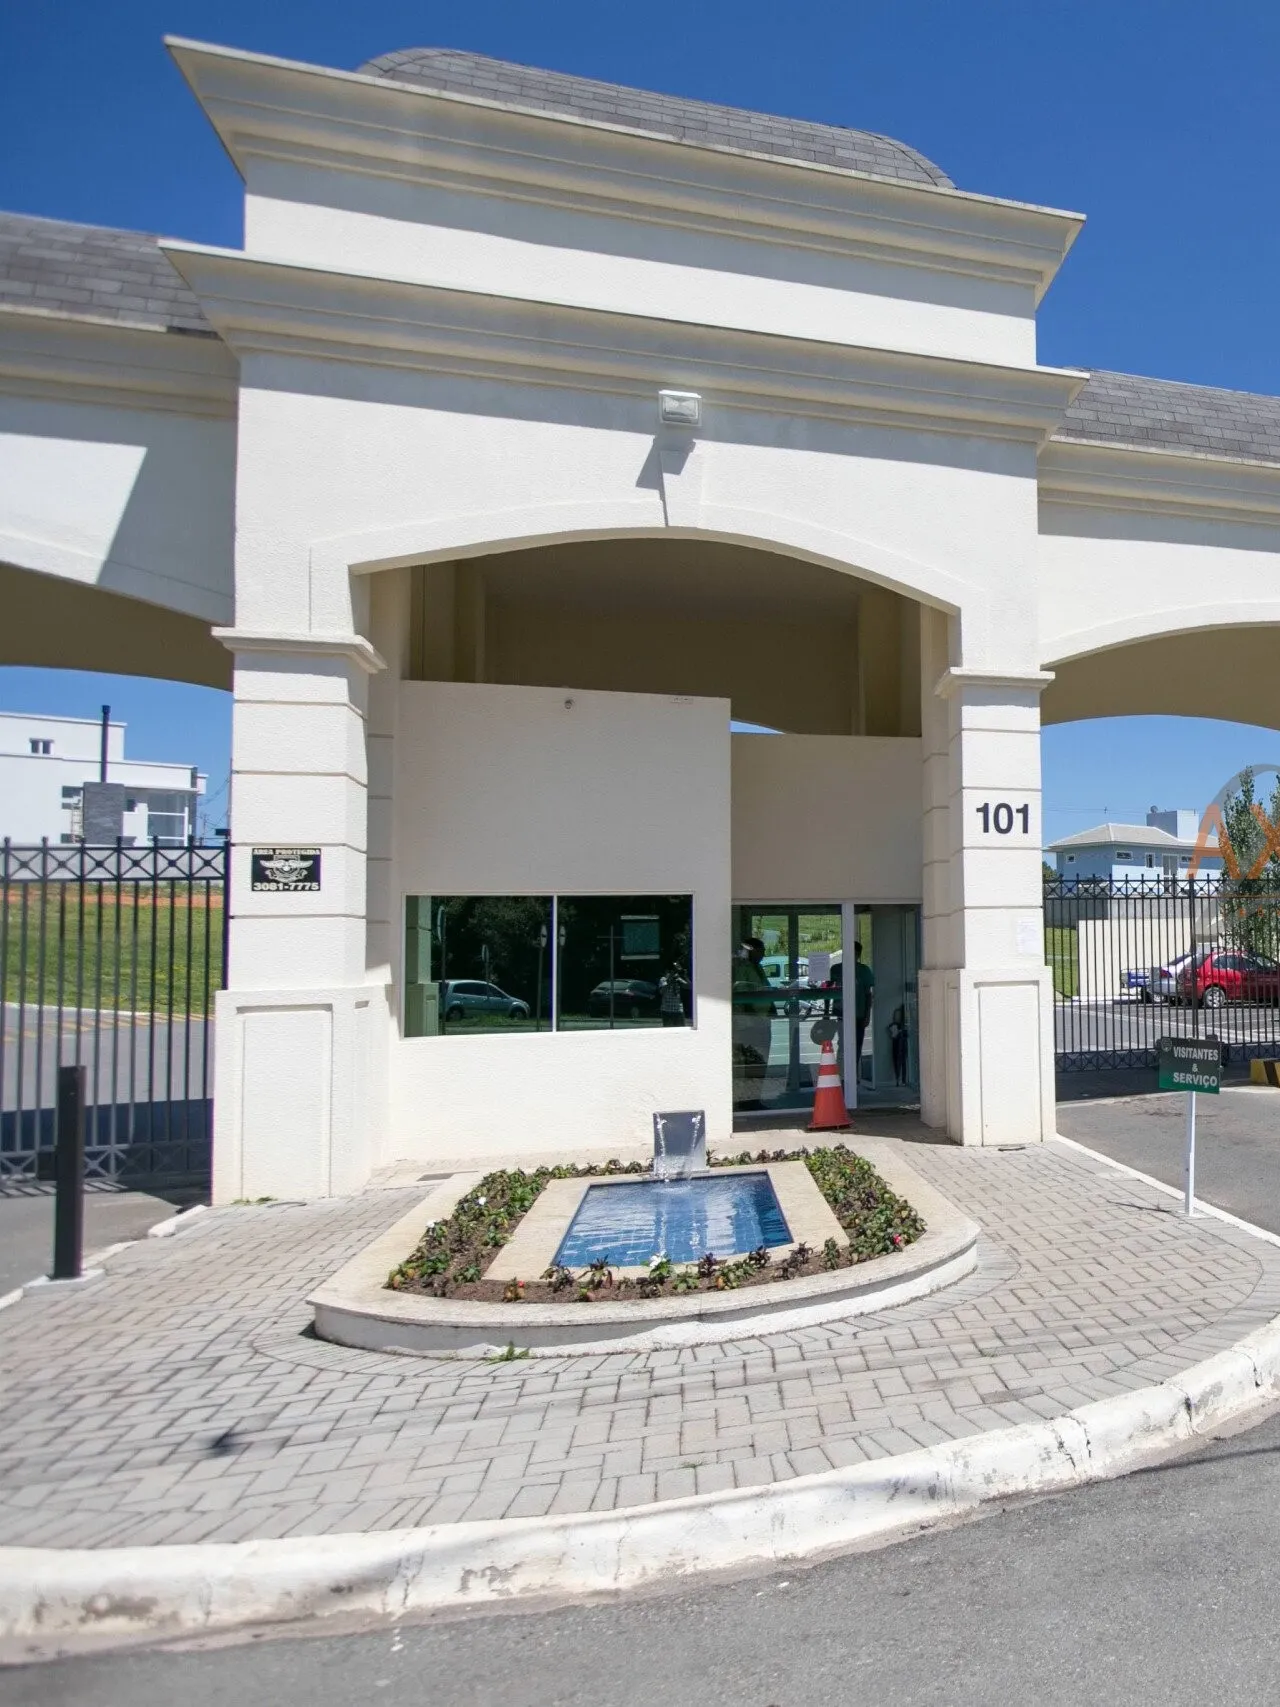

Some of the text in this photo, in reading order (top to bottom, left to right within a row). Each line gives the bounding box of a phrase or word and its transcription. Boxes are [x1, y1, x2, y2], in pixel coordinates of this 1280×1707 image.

[976, 802, 1029, 834] 101
[1173, 1046, 1219, 1061] VISITANTES
[1191, 1063, 1198, 1072] &
[1173, 1072, 1218, 1088] SERVIÇO
